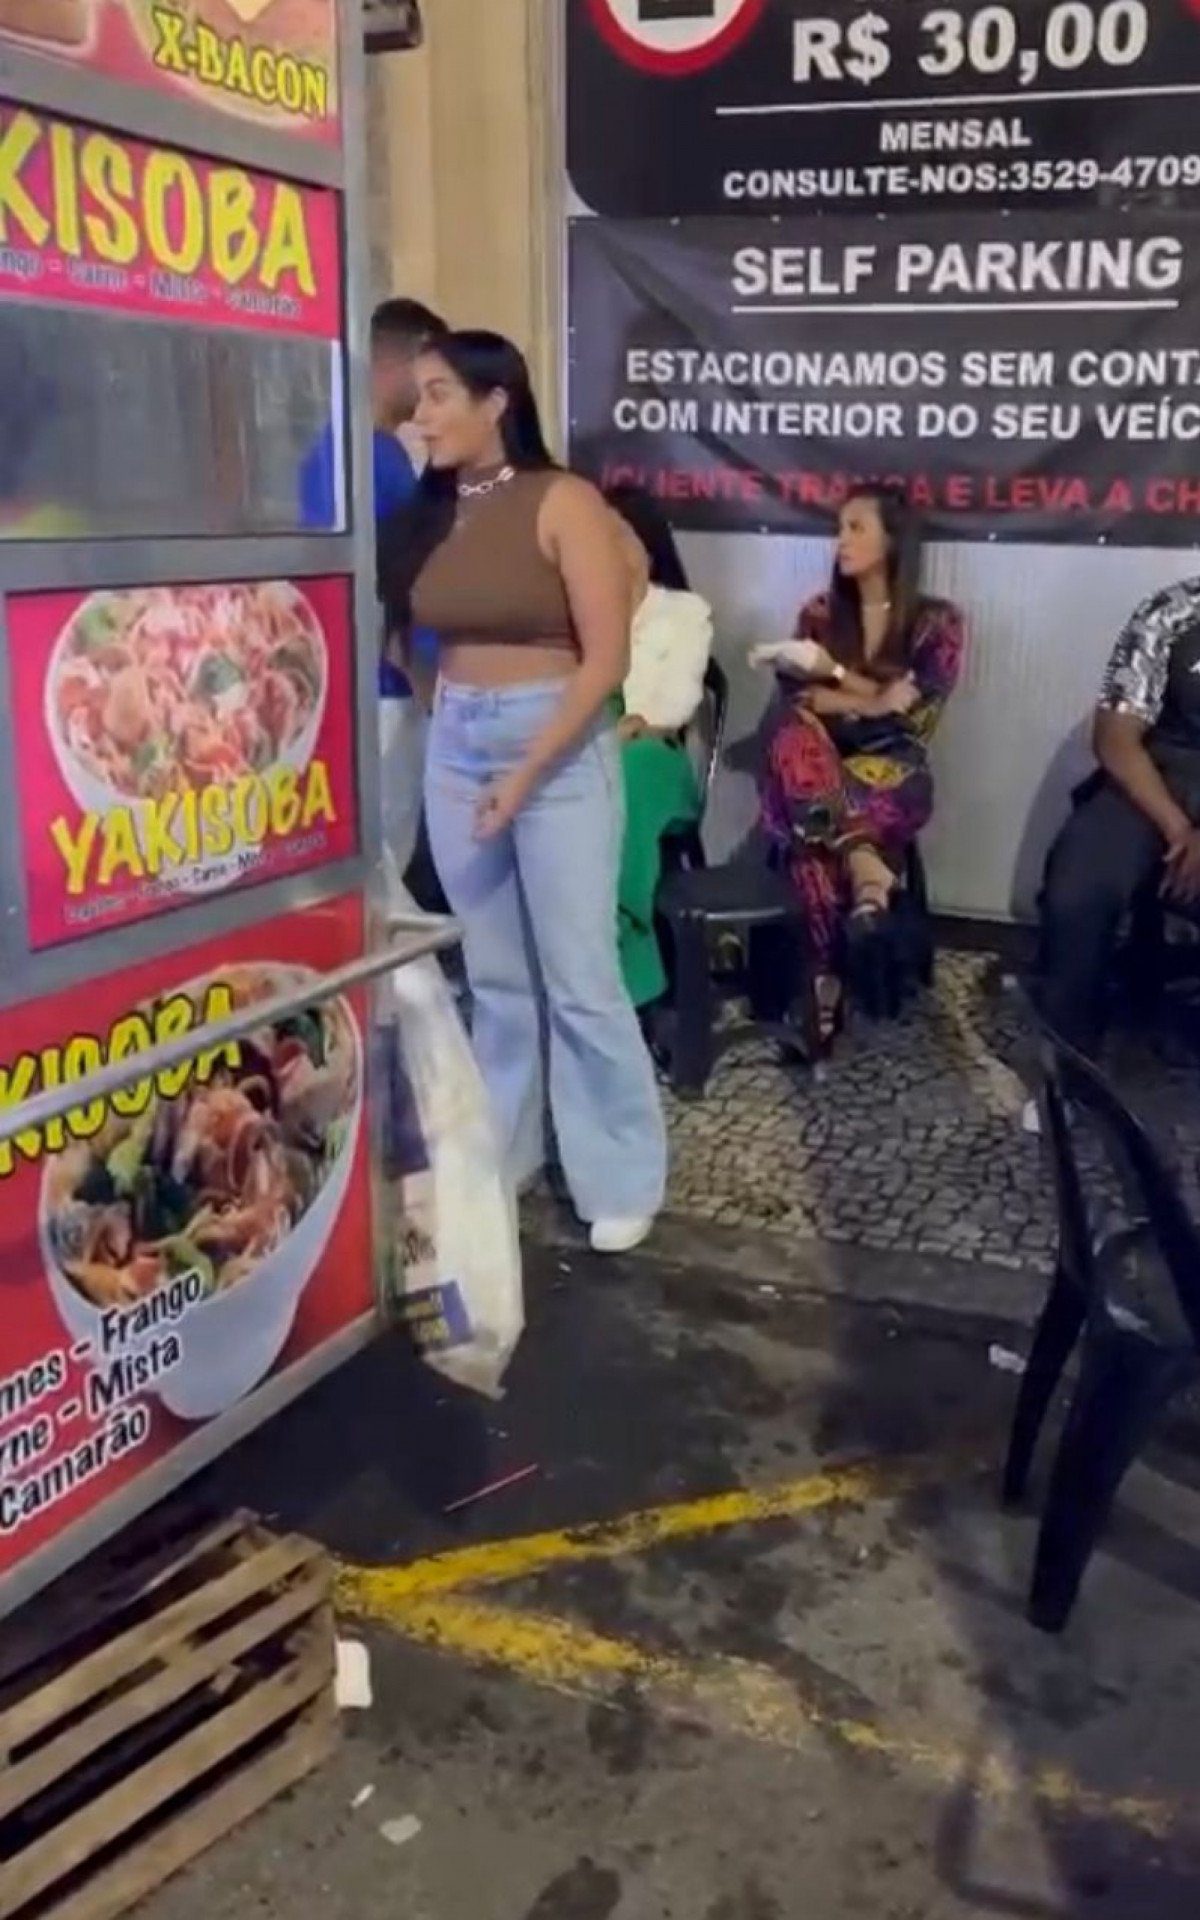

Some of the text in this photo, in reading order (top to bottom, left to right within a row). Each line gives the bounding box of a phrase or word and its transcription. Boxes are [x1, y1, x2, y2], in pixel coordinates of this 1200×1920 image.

[154, 8, 328, 119] X-BACON
[792, 0, 1148, 84] R$ 30,00
[880, 118, 1032, 152] MENSAL
[723, 154, 1200, 198] CONSULTE-NOS:3529-4709
[731, 236, 1183, 296] SELF PARKING
[626, 348, 1200, 387] ESTACIONAMOS SEM CONT
[612, 395, 1200, 440] COM INTERIOR DO SEU VEÍC
[945, 475, 973, 508] E
[985, 475, 1089, 509] LEVA
[1104, 477, 1133, 511] A
[51, 760, 337, 895] YAKISOBA
[101, 1271, 202, 1353] Frango
[88, 1335, 181, 1416] Mista
[0, 1406, 147, 1530] Camarão
